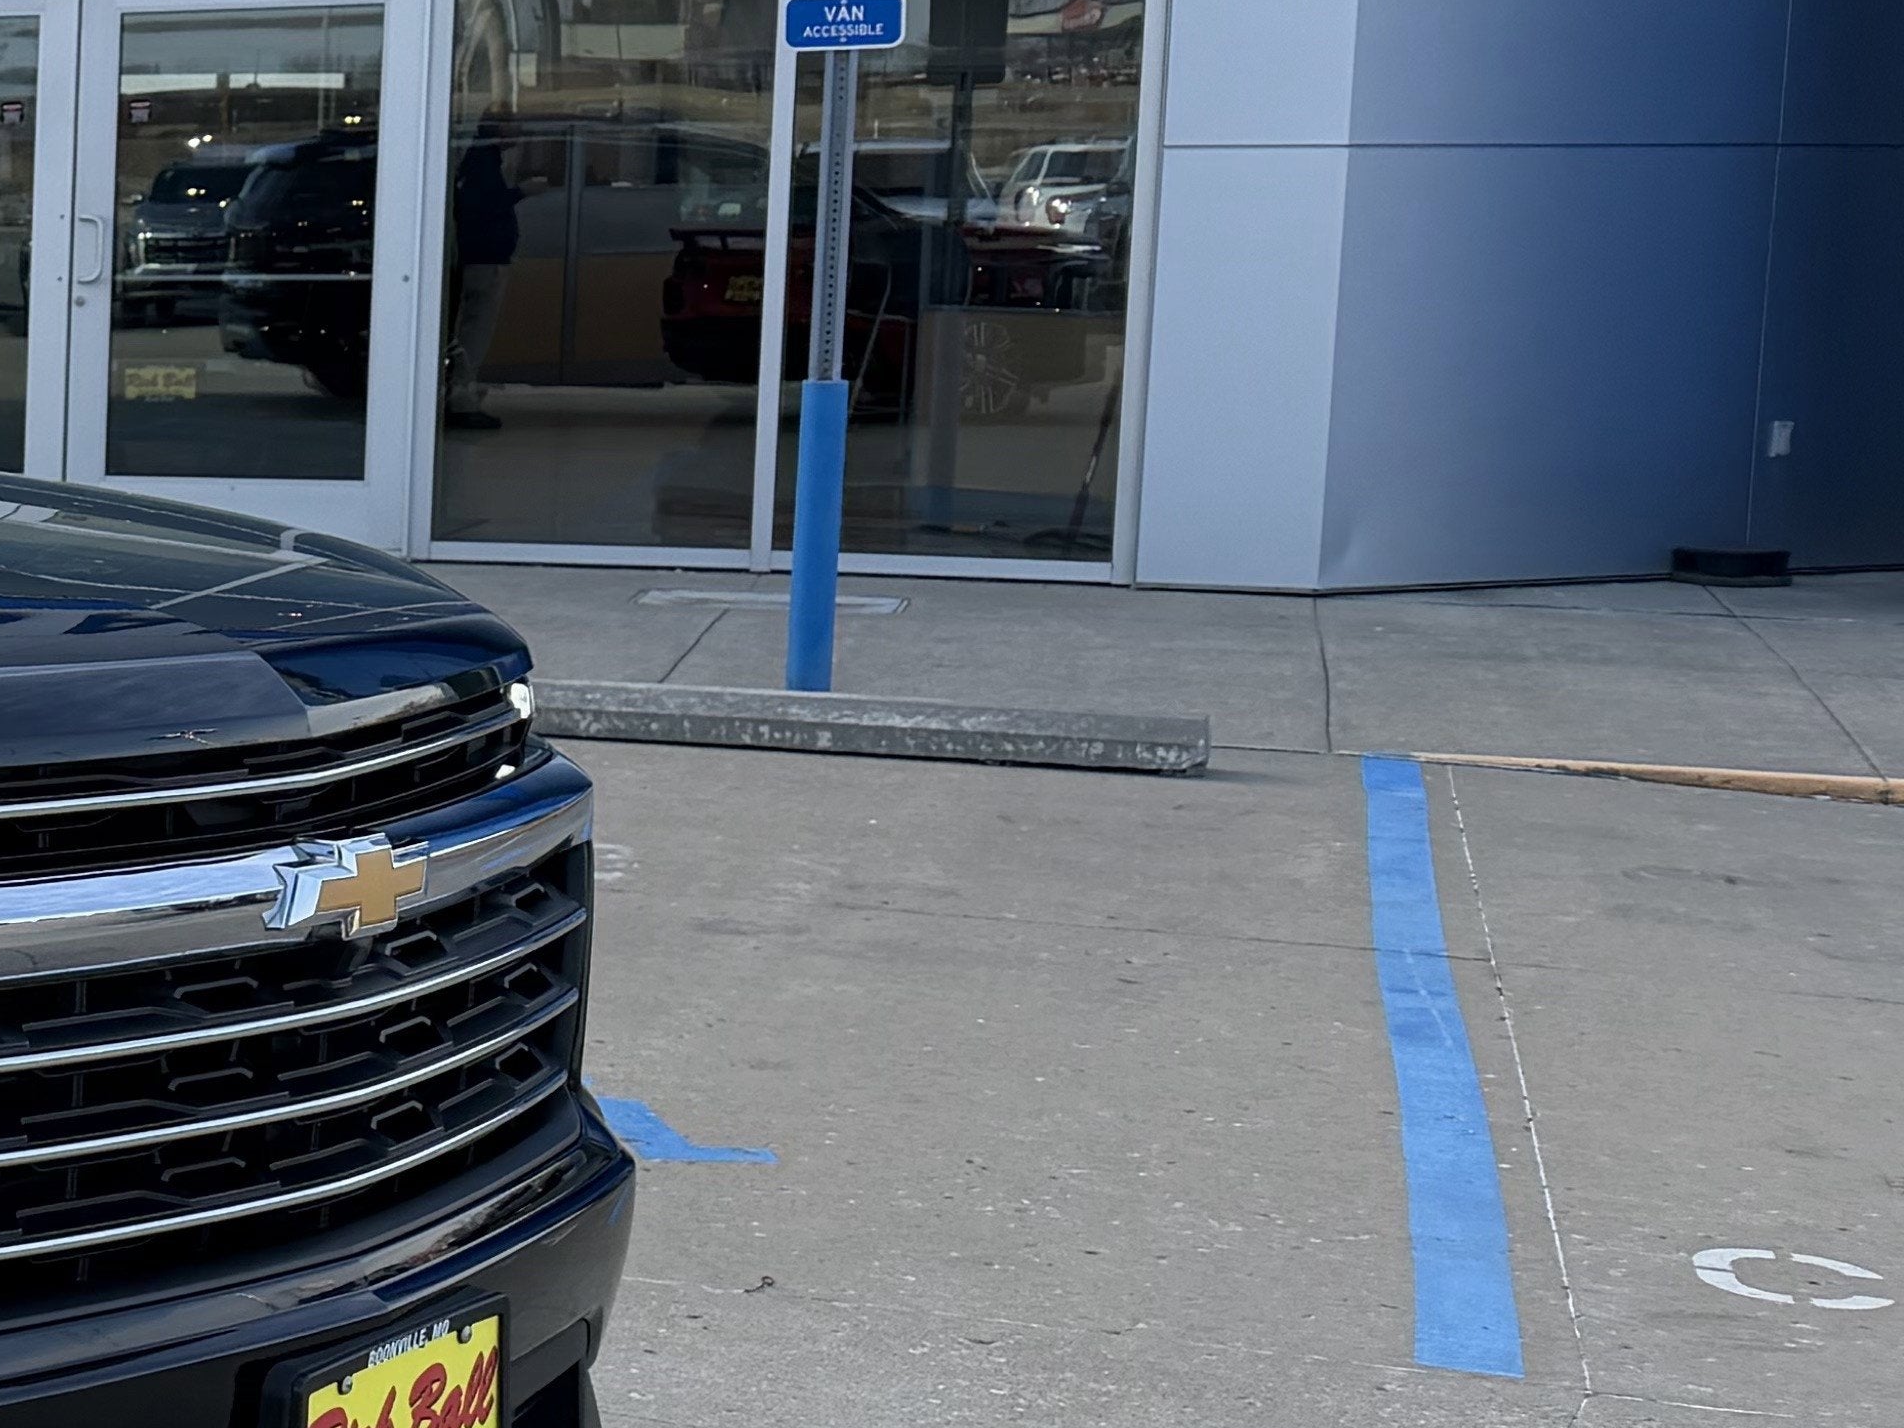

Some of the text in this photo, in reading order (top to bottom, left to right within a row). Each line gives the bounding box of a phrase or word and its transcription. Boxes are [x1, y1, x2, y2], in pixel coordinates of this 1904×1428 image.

[824, 5, 865, 22] VAN
[803, 23, 884, 38] ACCESSIBLE
[432, 1319, 450, 1338] MO
